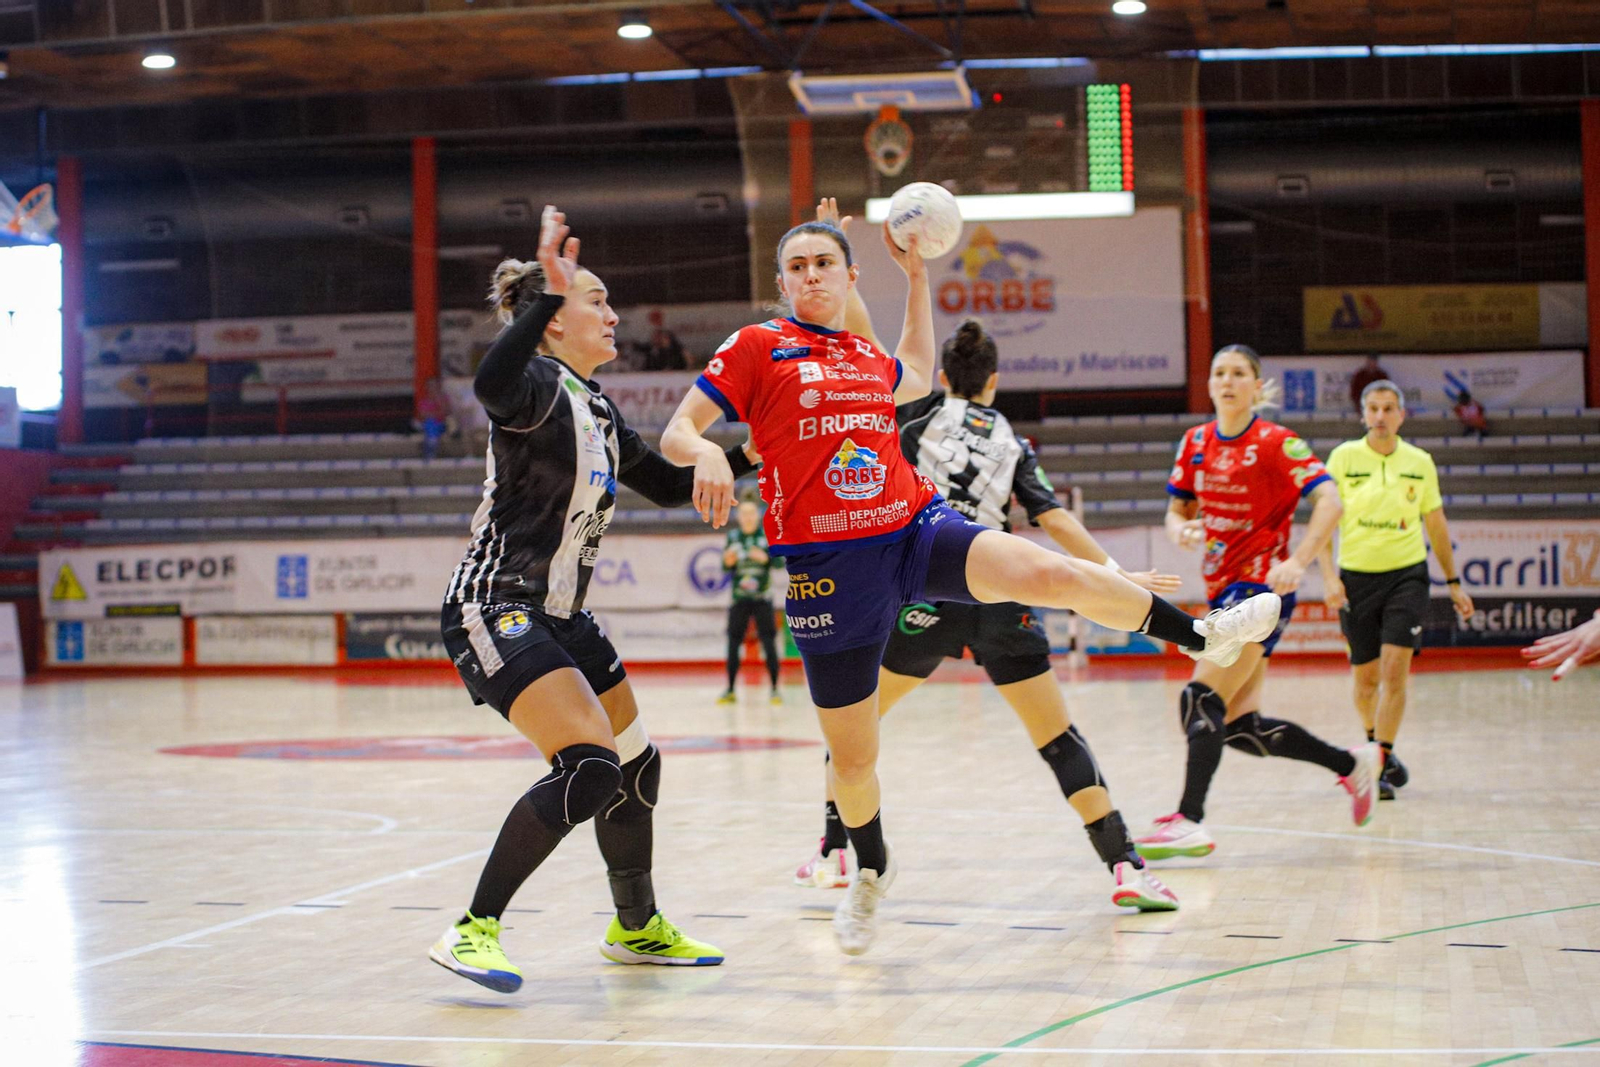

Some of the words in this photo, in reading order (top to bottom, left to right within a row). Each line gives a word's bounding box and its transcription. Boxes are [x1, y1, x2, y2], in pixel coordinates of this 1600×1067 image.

[937, 278, 1055, 314] ORBE
[998, 354, 1059, 372] cados
[1063, 358, 1075, 376] y
[1079, 352, 1169, 370] Mariscos
[825, 370, 842, 380] DE
[841, 371, 883, 383] GALICIA
[824, 390, 872, 402] Xacobeo
[872, 392, 893, 404] 21-22
[821, 413, 895, 436] RUBENSA
[1241, 444, 1259, 467] 5
[826, 466, 885, 487] ORBE
[849, 499, 909, 521] DEPUTACIÓN
[850, 507, 910, 530] PONTEVEDRA
[1562, 530, 1600, 587] 32
[905, 609, 941, 628] CSIF
